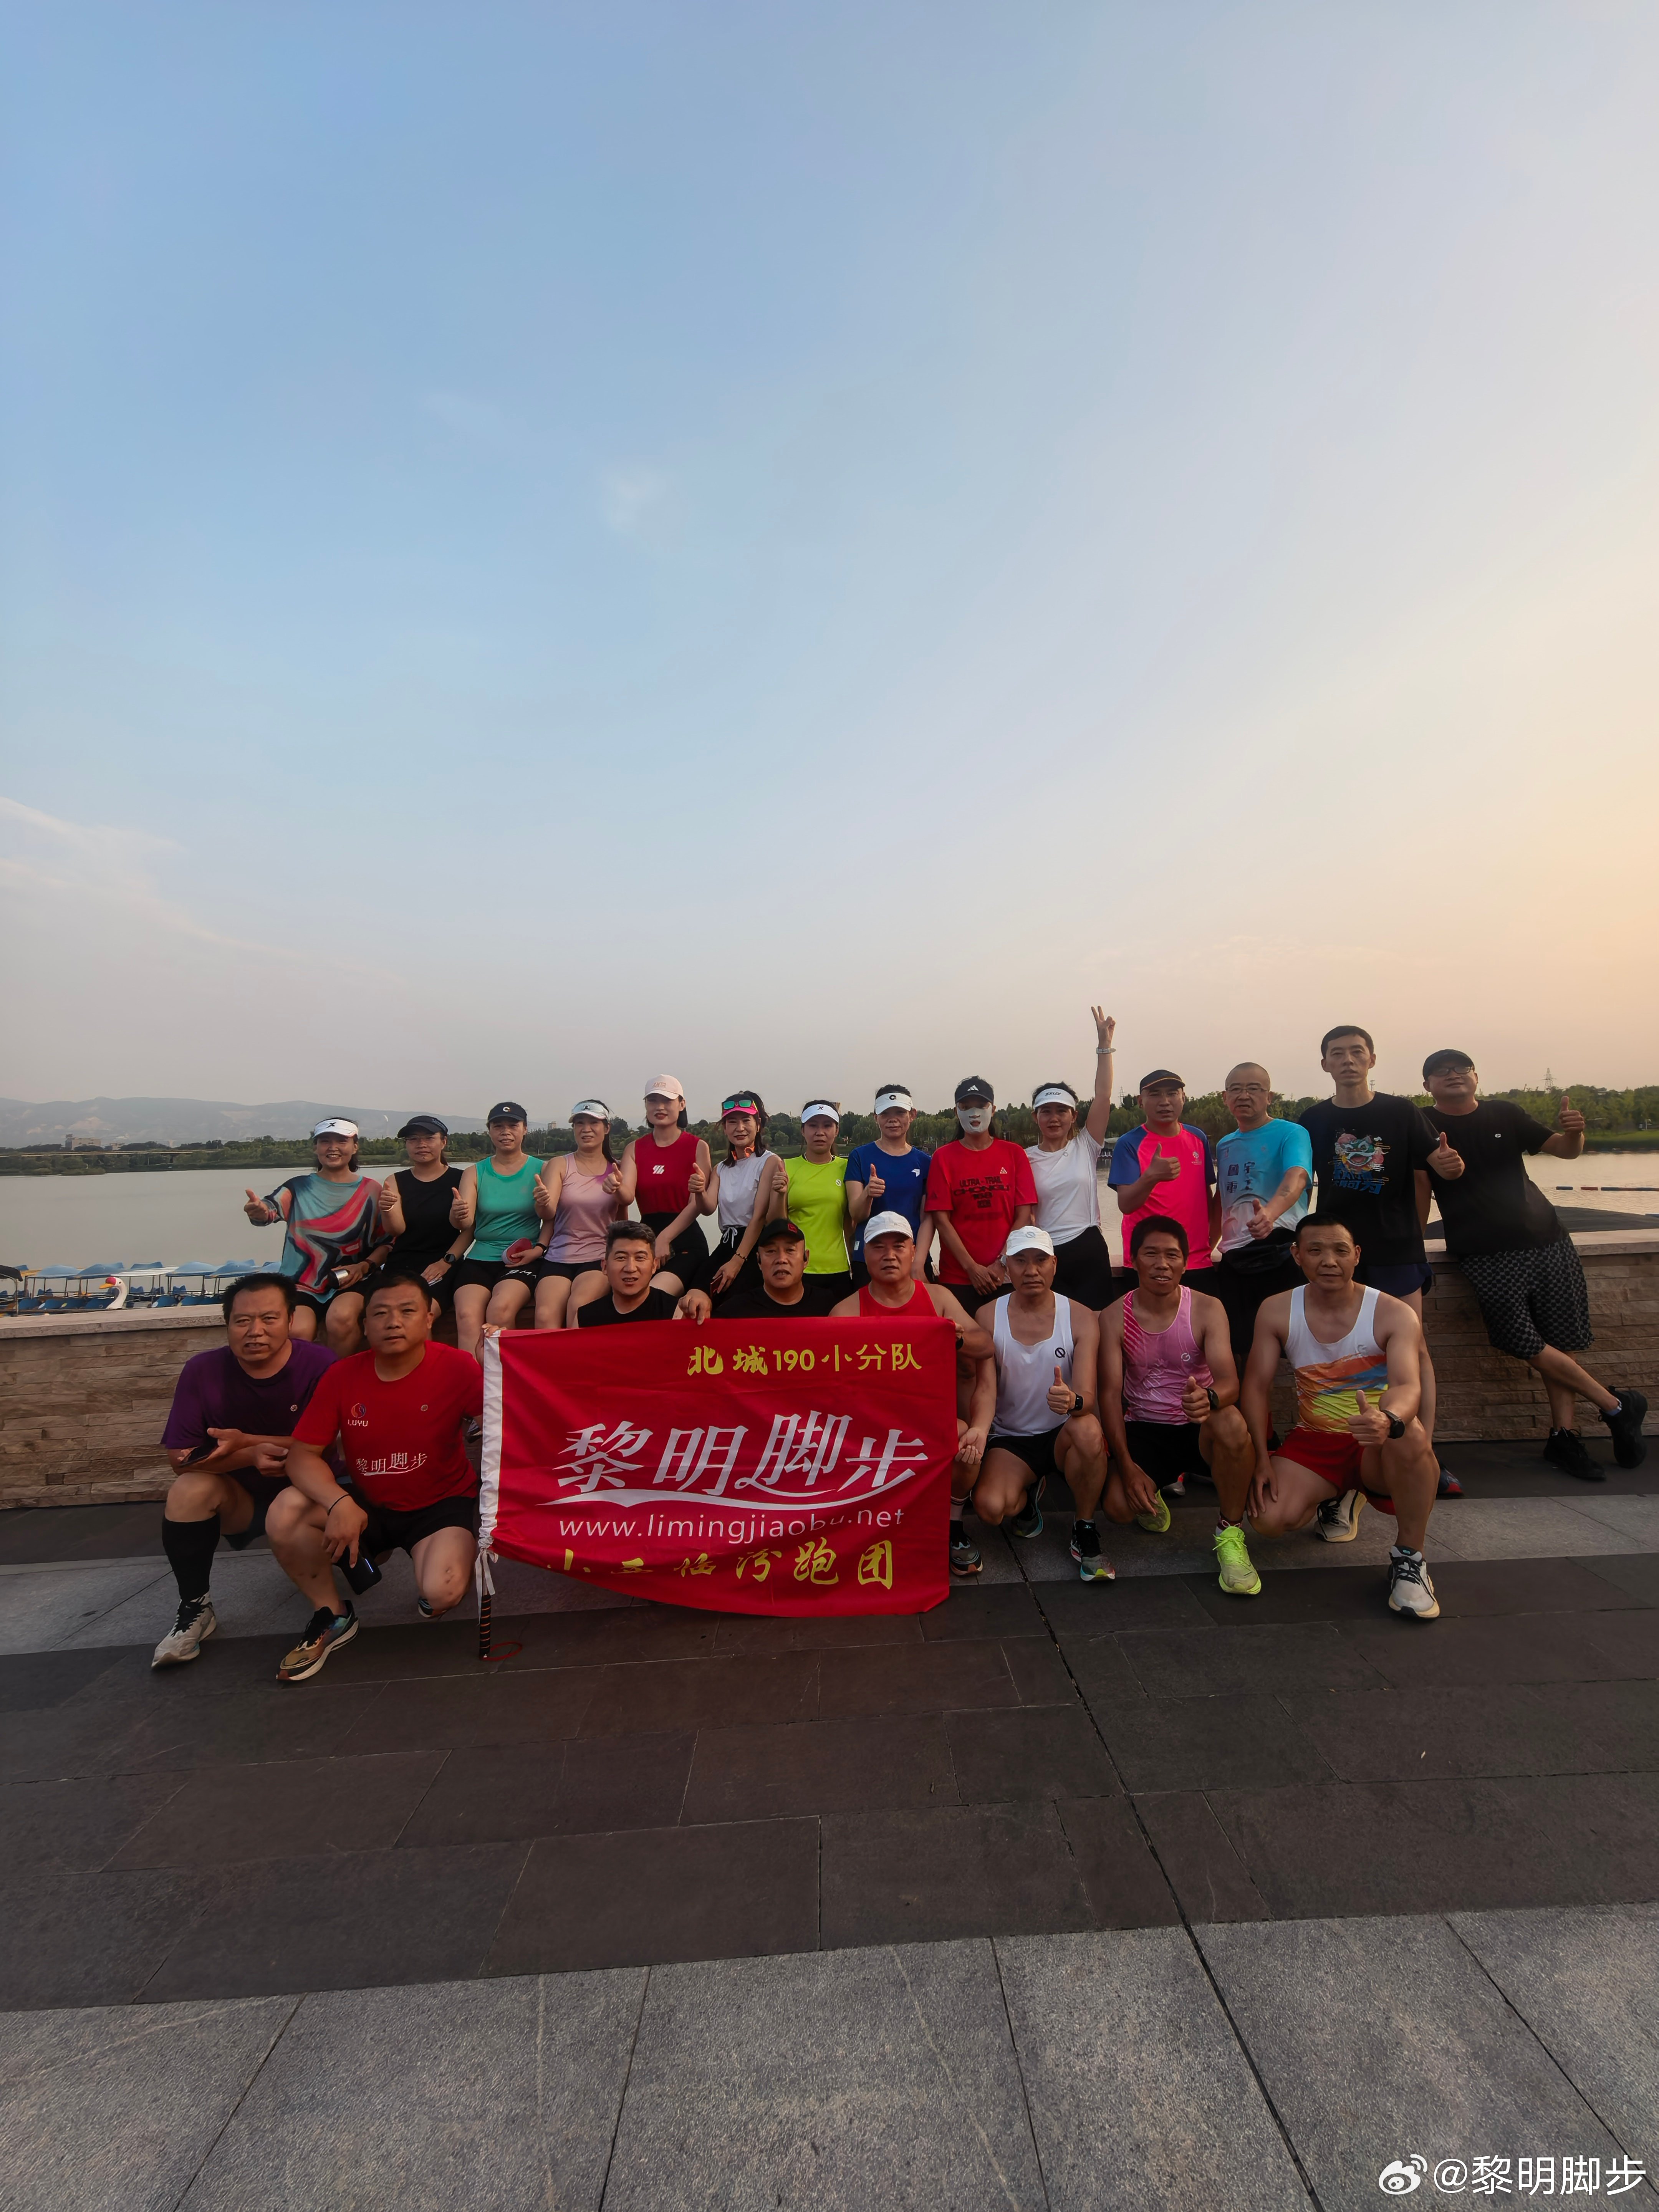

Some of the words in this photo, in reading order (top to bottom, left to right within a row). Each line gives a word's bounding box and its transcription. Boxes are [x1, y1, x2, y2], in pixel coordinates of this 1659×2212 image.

[687, 1343, 922, 1376] 北城190小分队
[356, 1452, 427, 1475] 黎明脚步
[552, 1410, 928, 1498] 黎明脚步
[560, 1508, 904, 1544] www.limingjiaobu.net
